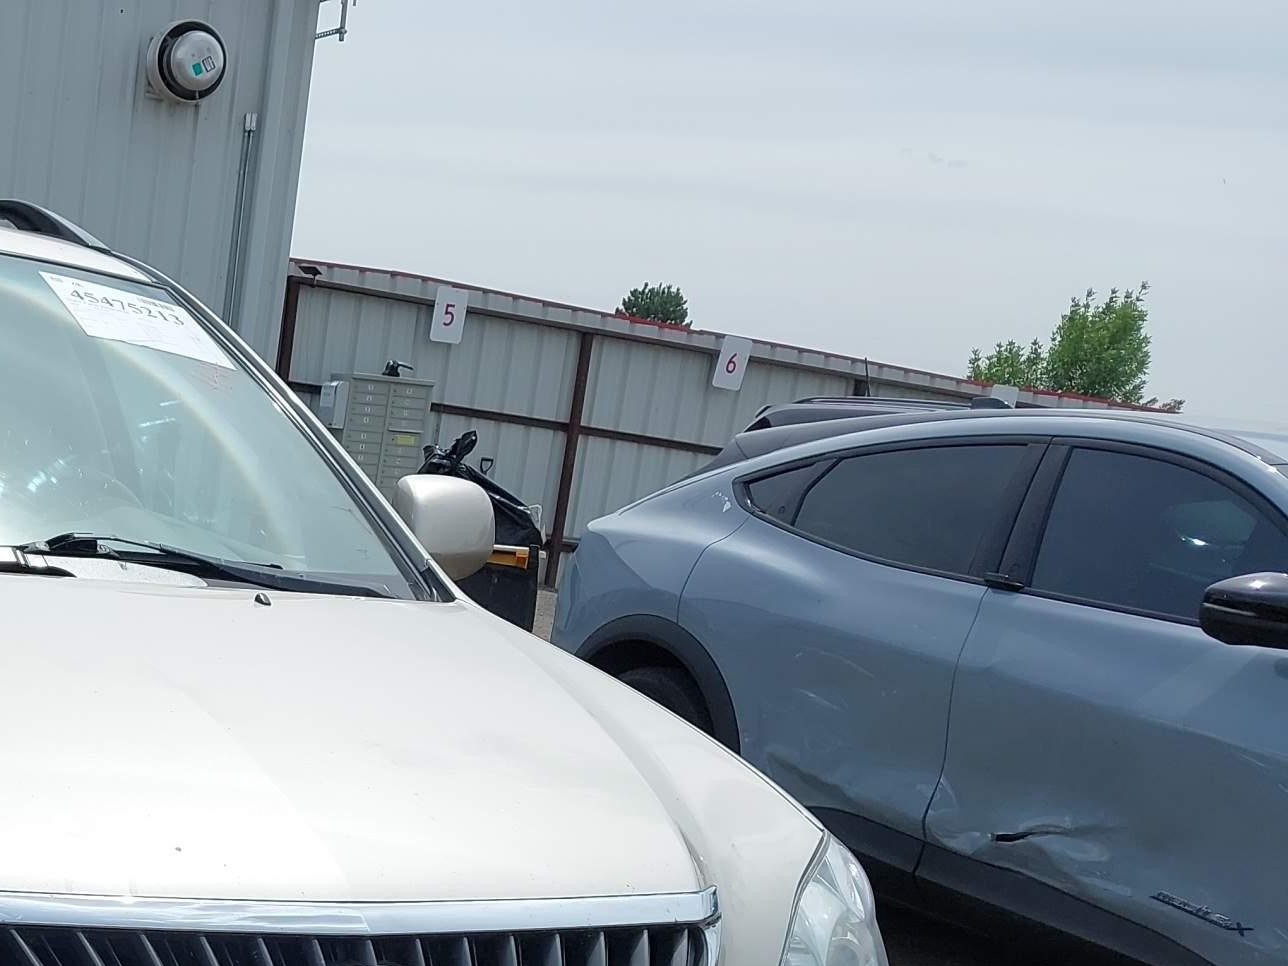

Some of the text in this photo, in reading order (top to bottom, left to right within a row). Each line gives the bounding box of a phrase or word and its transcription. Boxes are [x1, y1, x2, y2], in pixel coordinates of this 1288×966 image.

[70, 289, 185, 326] 45475213
[442, 303, 456, 327] 5
[725, 352, 737, 374] 6
